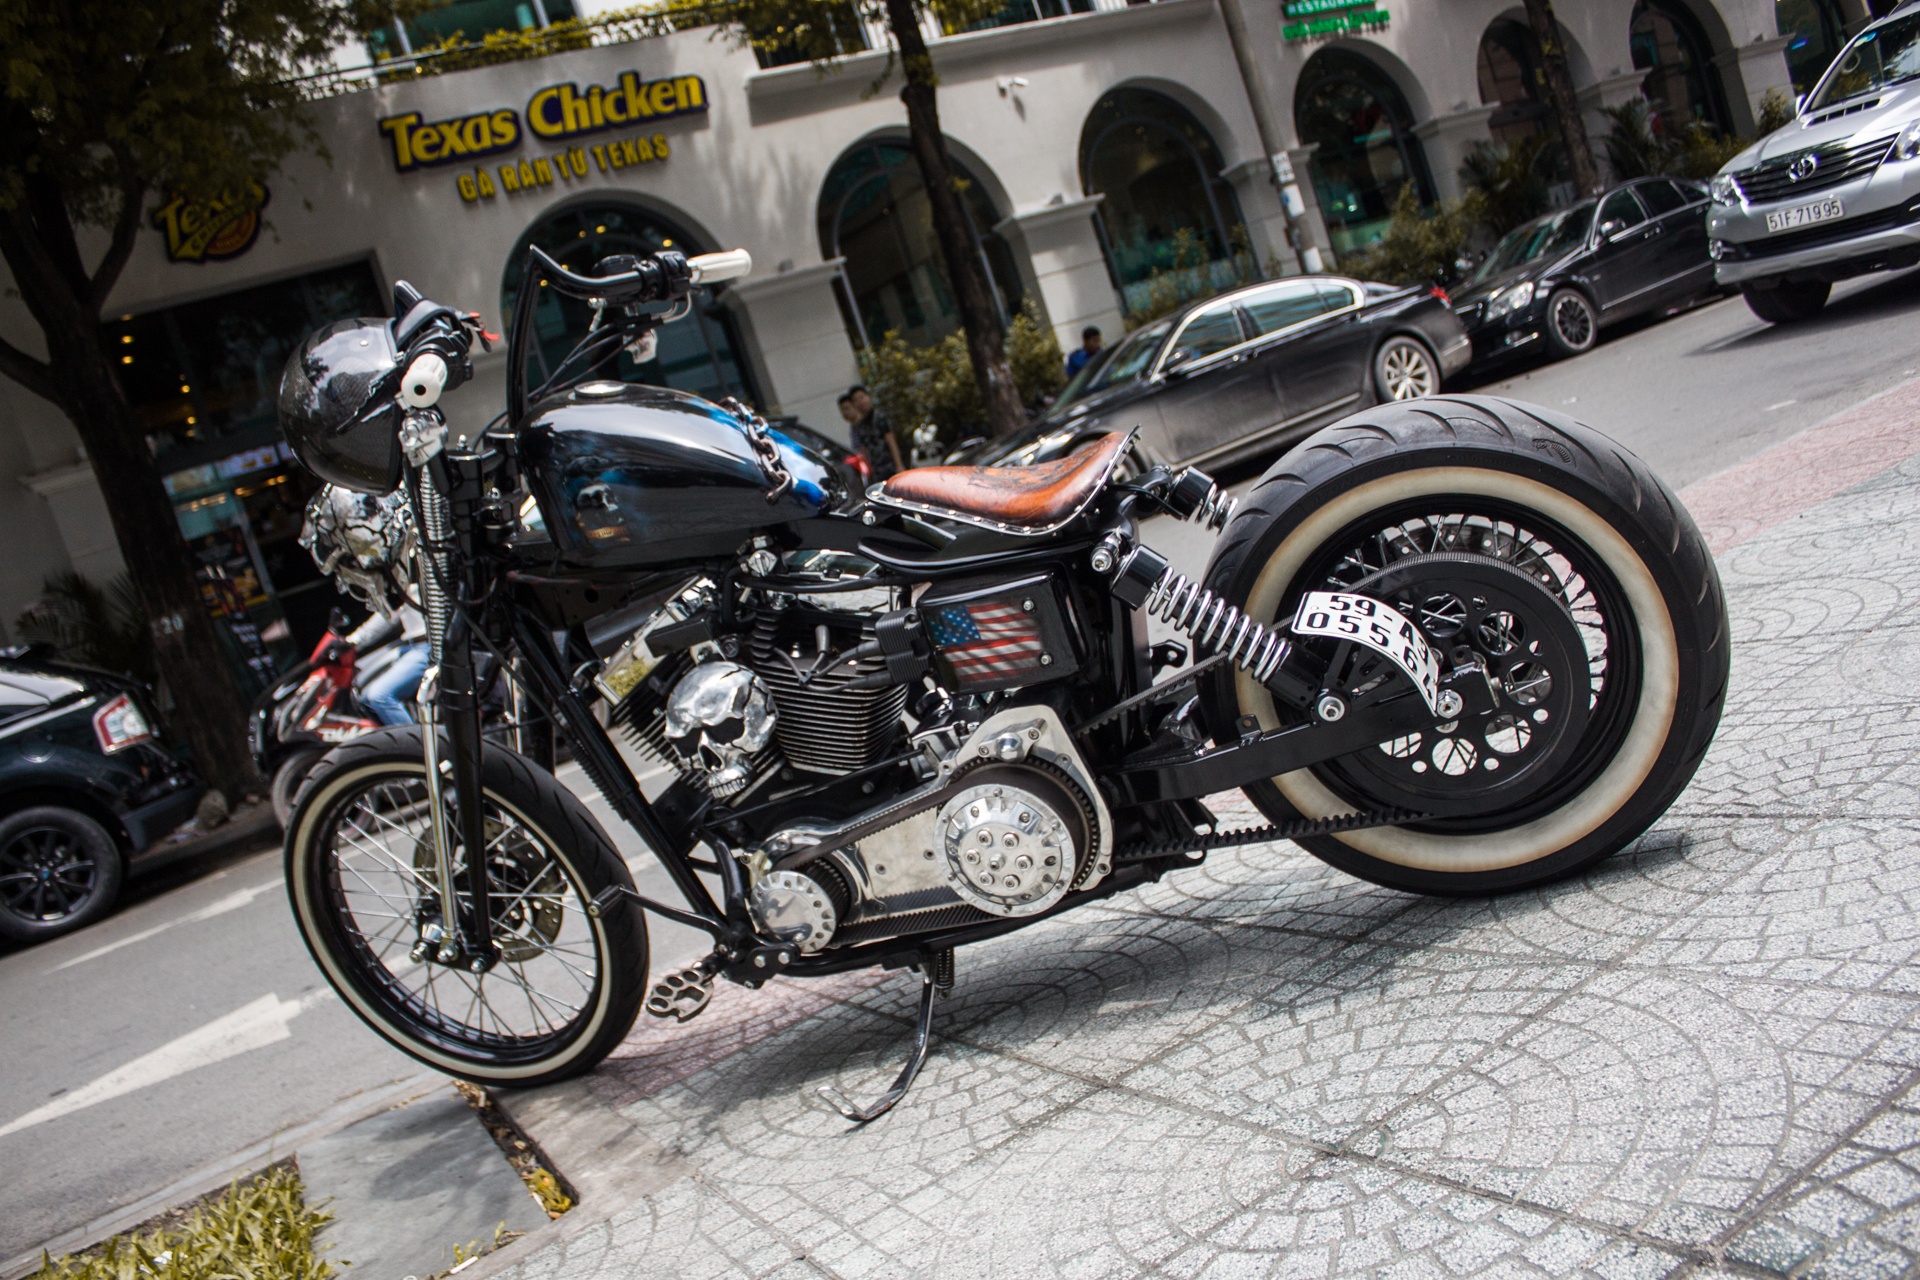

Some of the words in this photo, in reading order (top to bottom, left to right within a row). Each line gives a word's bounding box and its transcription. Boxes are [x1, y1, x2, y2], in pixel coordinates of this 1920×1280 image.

[381, 109, 519, 169] Texas
[528, 72, 704, 137] Chicken
[591, 133, 671, 171] TEXAS
